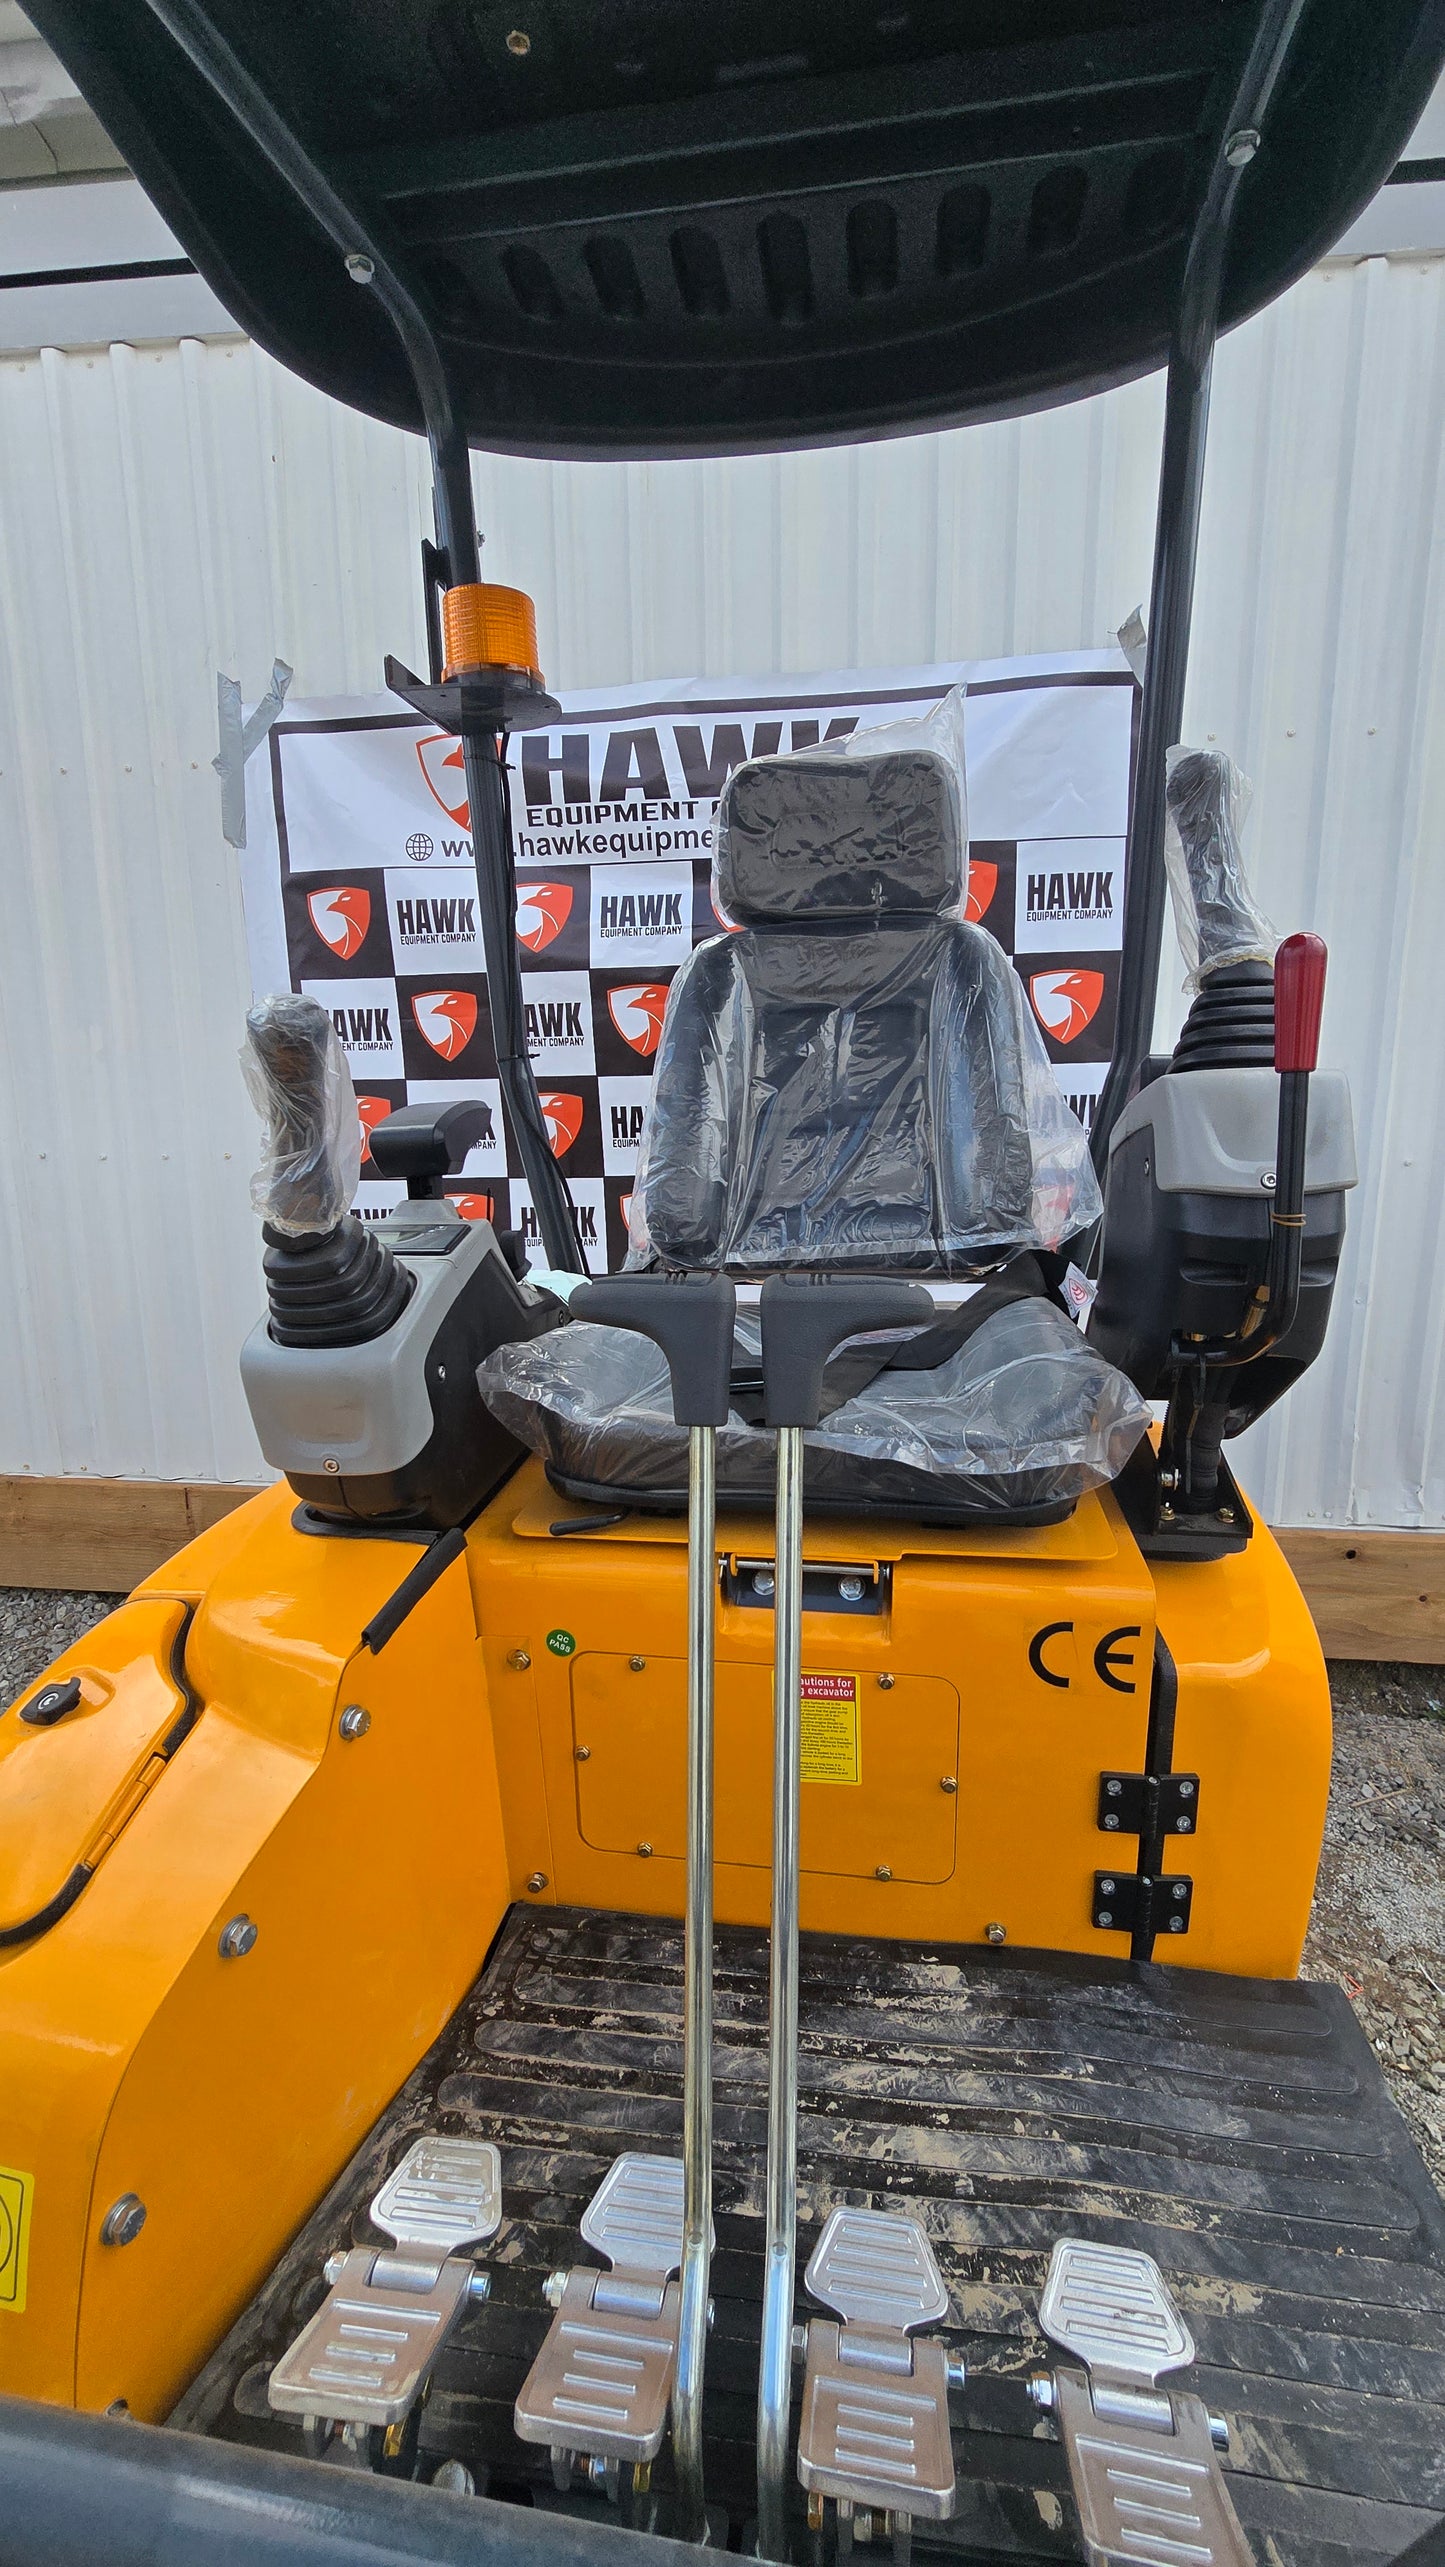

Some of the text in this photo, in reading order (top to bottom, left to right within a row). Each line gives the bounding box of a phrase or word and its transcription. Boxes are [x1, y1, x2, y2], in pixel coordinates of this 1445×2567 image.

[526, 801, 699, 828] EQUIPMENT
[1027, 872, 1114, 910] HAWK
[396, 898, 476, 935] HAWK
[600, 893, 682, 928] HAWK
[1027, 909, 1113, 922] EQUIPMENT COMPANY
[600, 925, 682, 938] EQUIPMENT COMPANY
[400, 933, 476, 945] EQUIPMENT COMPANY
[324, 1008, 393, 1041] AWK
[523, 1002, 584, 1037] AWK
[358, 1042, 393, 1051] COMPANY
[549, 1037, 584, 1047] COMPANY
[610, 1106, 643, 1138] HA
[612, 1139, 640, 1148] EQUIPM
[556, 1633, 570, 1643] QC
[549, 1638, 571, 1653] PASS
[1028, 1621, 1142, 1694] CE
[837, 1677, 852, 1688] for
[807, 1687, 854, 1697] excavator
